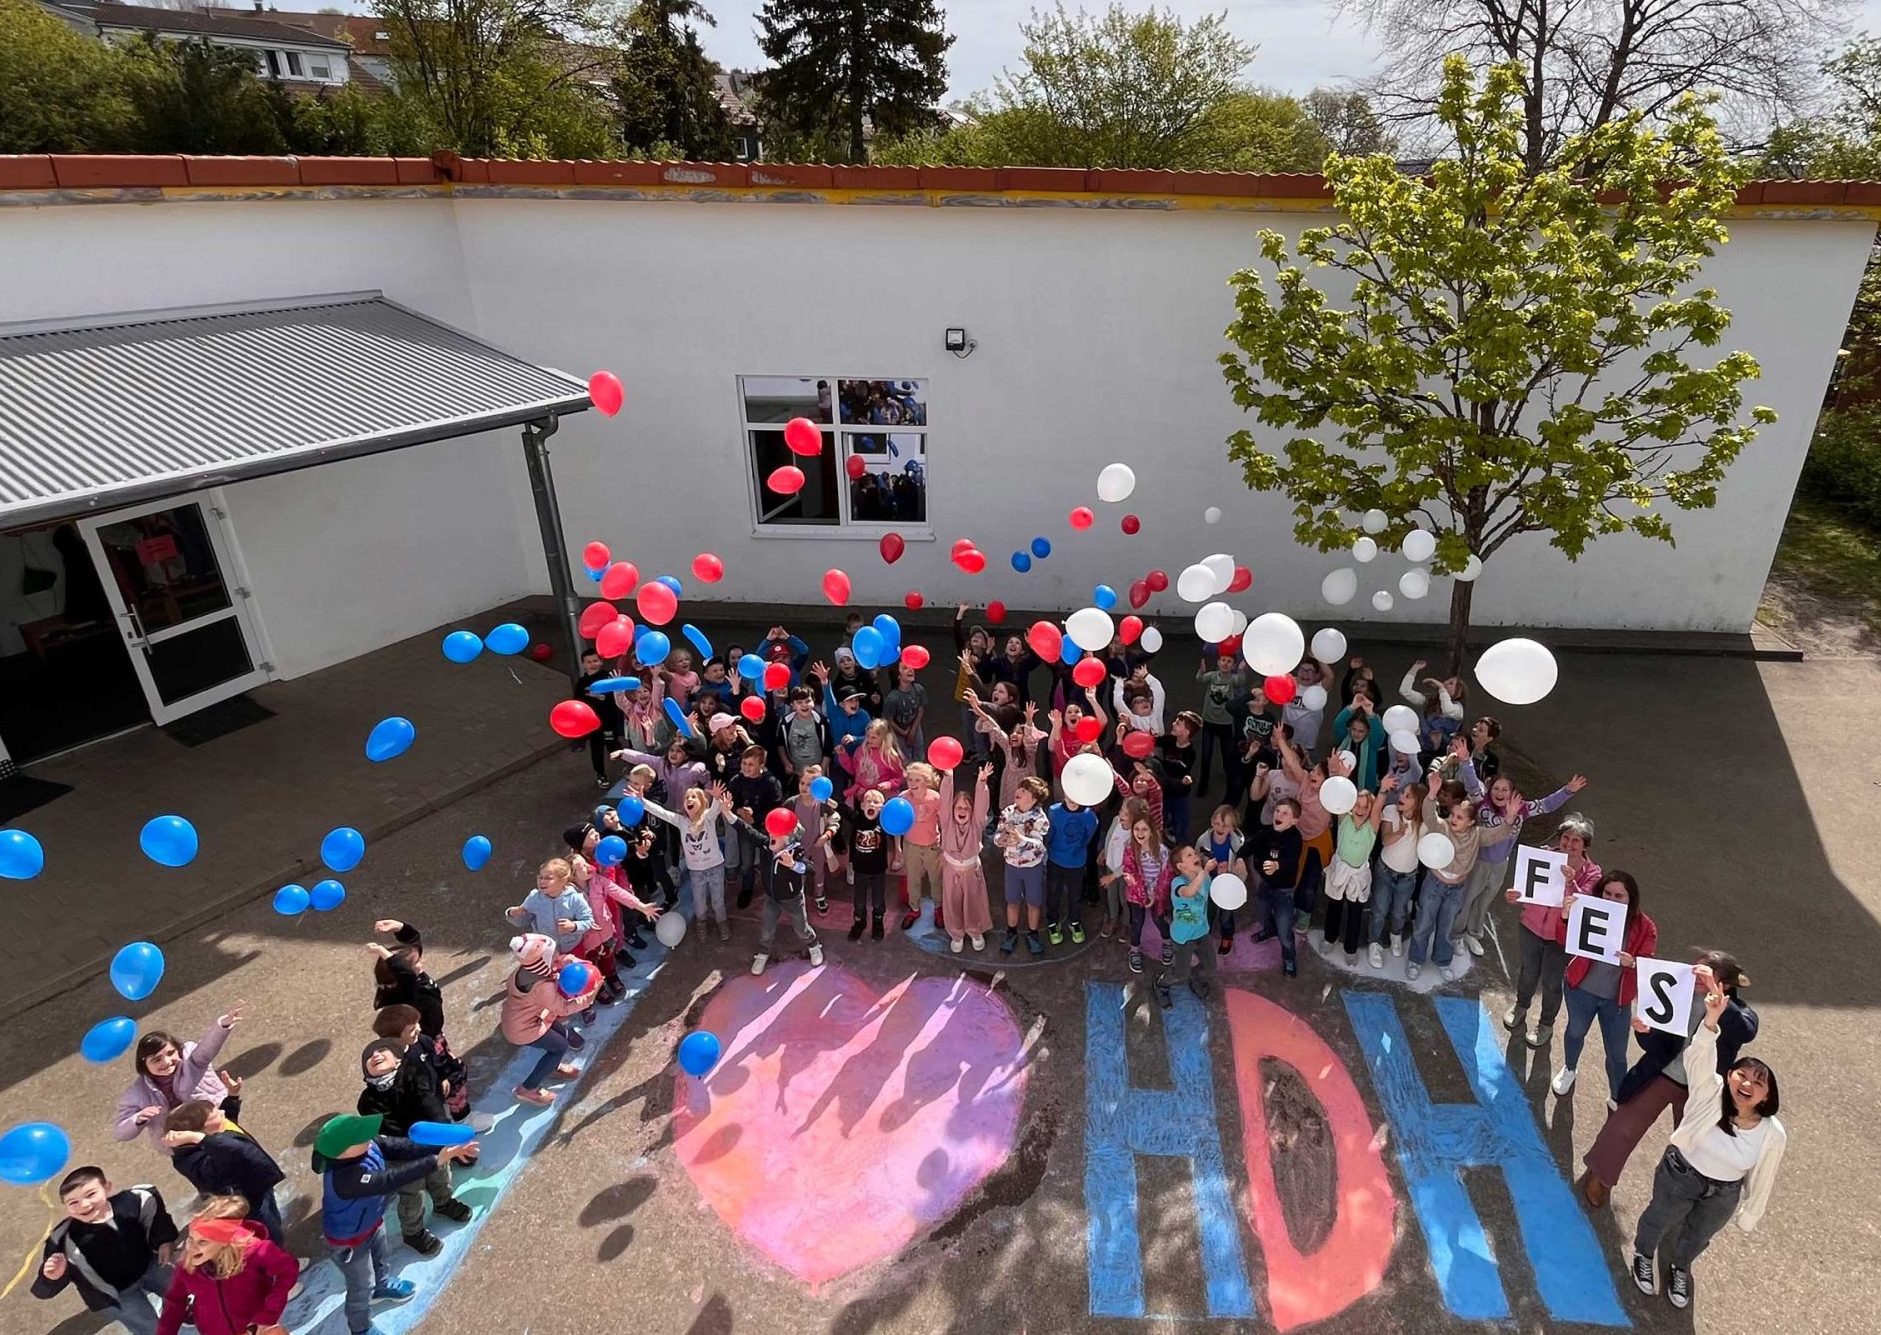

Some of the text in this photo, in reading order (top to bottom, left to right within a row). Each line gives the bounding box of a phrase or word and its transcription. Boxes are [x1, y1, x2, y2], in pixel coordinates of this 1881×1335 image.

[1525, 859, 1550, 898] F
[1578, 907, 1609, 956] E
[1645, 971, 1678, 1025] S
